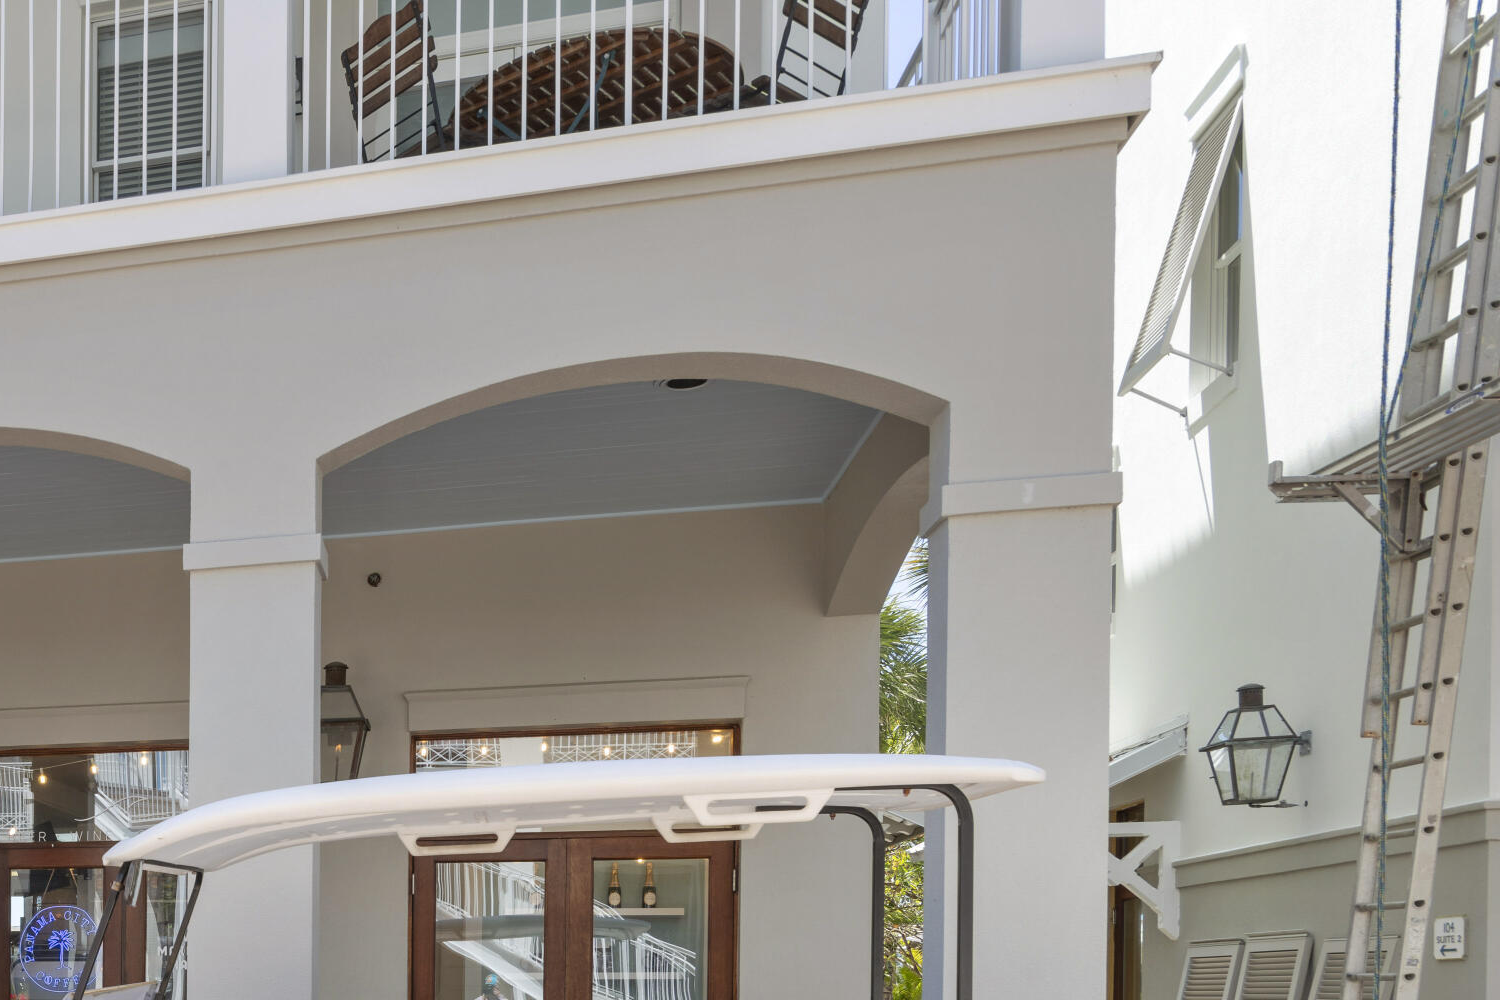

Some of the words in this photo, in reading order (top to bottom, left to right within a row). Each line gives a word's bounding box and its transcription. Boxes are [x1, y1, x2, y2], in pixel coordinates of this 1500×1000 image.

[1443, 922, 1455, 933] 104
[23, 911, 57, 964] PANAMA
[63, 910, 99, 936] CITY
[1436, 935, 1455, 944] SUITE
[1457, 934, 1462, 943] 2
[35, 970, 84, 988] COFFE
